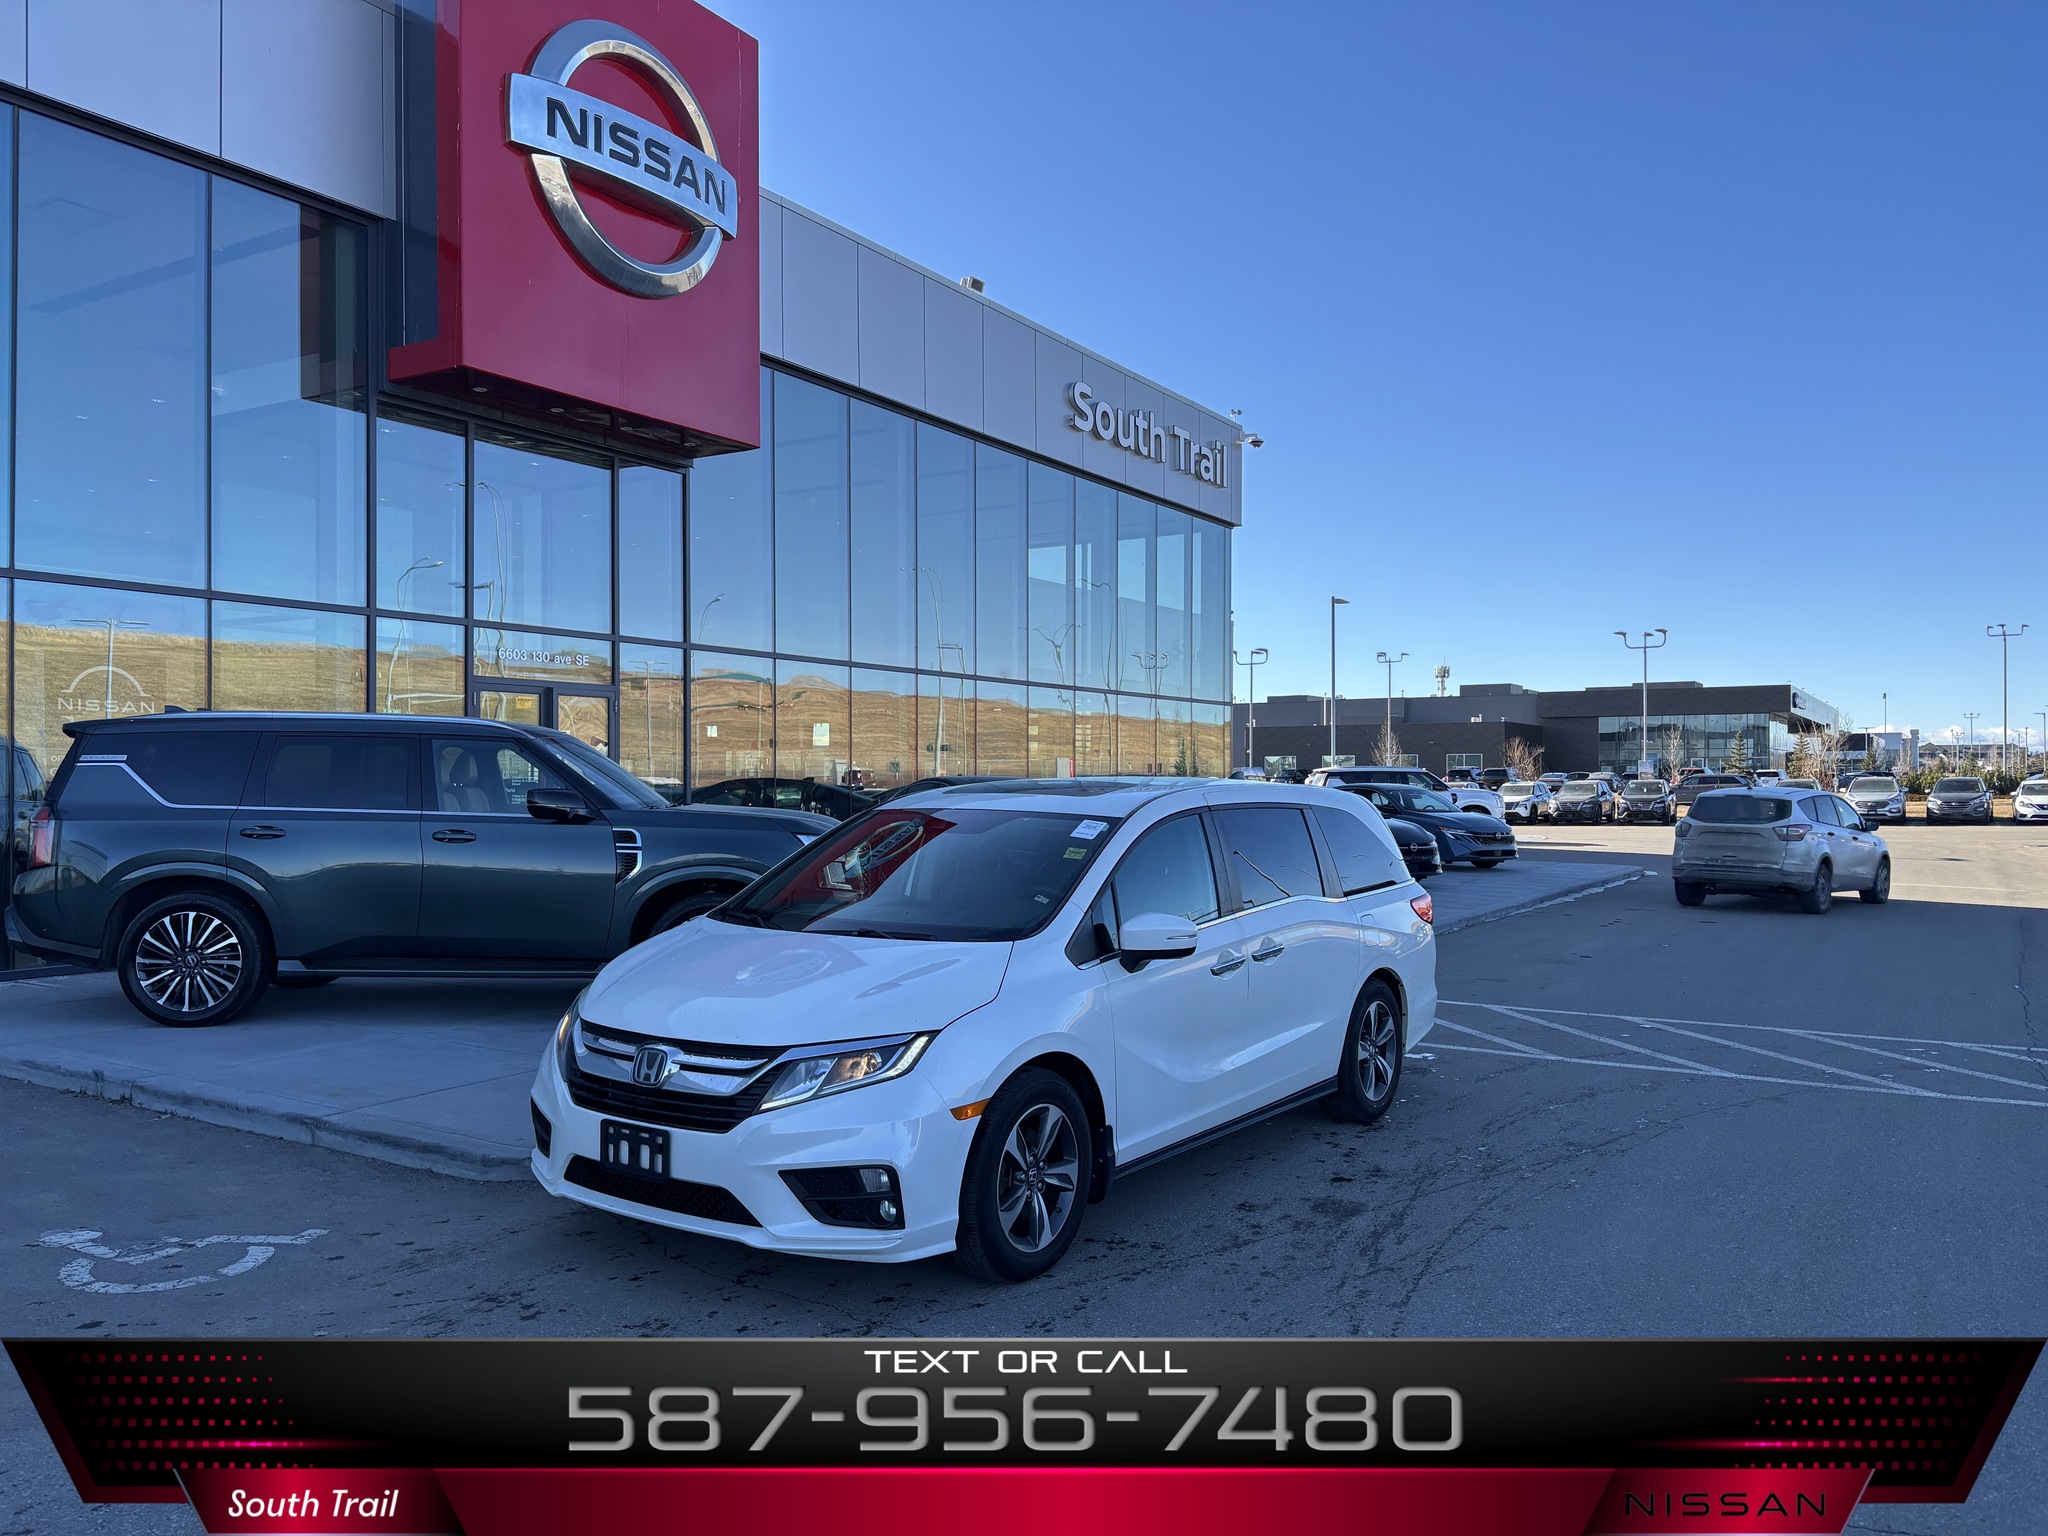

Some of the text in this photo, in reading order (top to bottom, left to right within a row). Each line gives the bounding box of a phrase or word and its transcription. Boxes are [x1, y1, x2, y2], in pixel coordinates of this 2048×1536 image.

[546, 96, 726, 216] NISSAN
[1069, 381, 1228, 488] South Trail
[498, 647, 590, 666] 6603 130 ave SE
[57, 697, 155, 714] NISSAN
